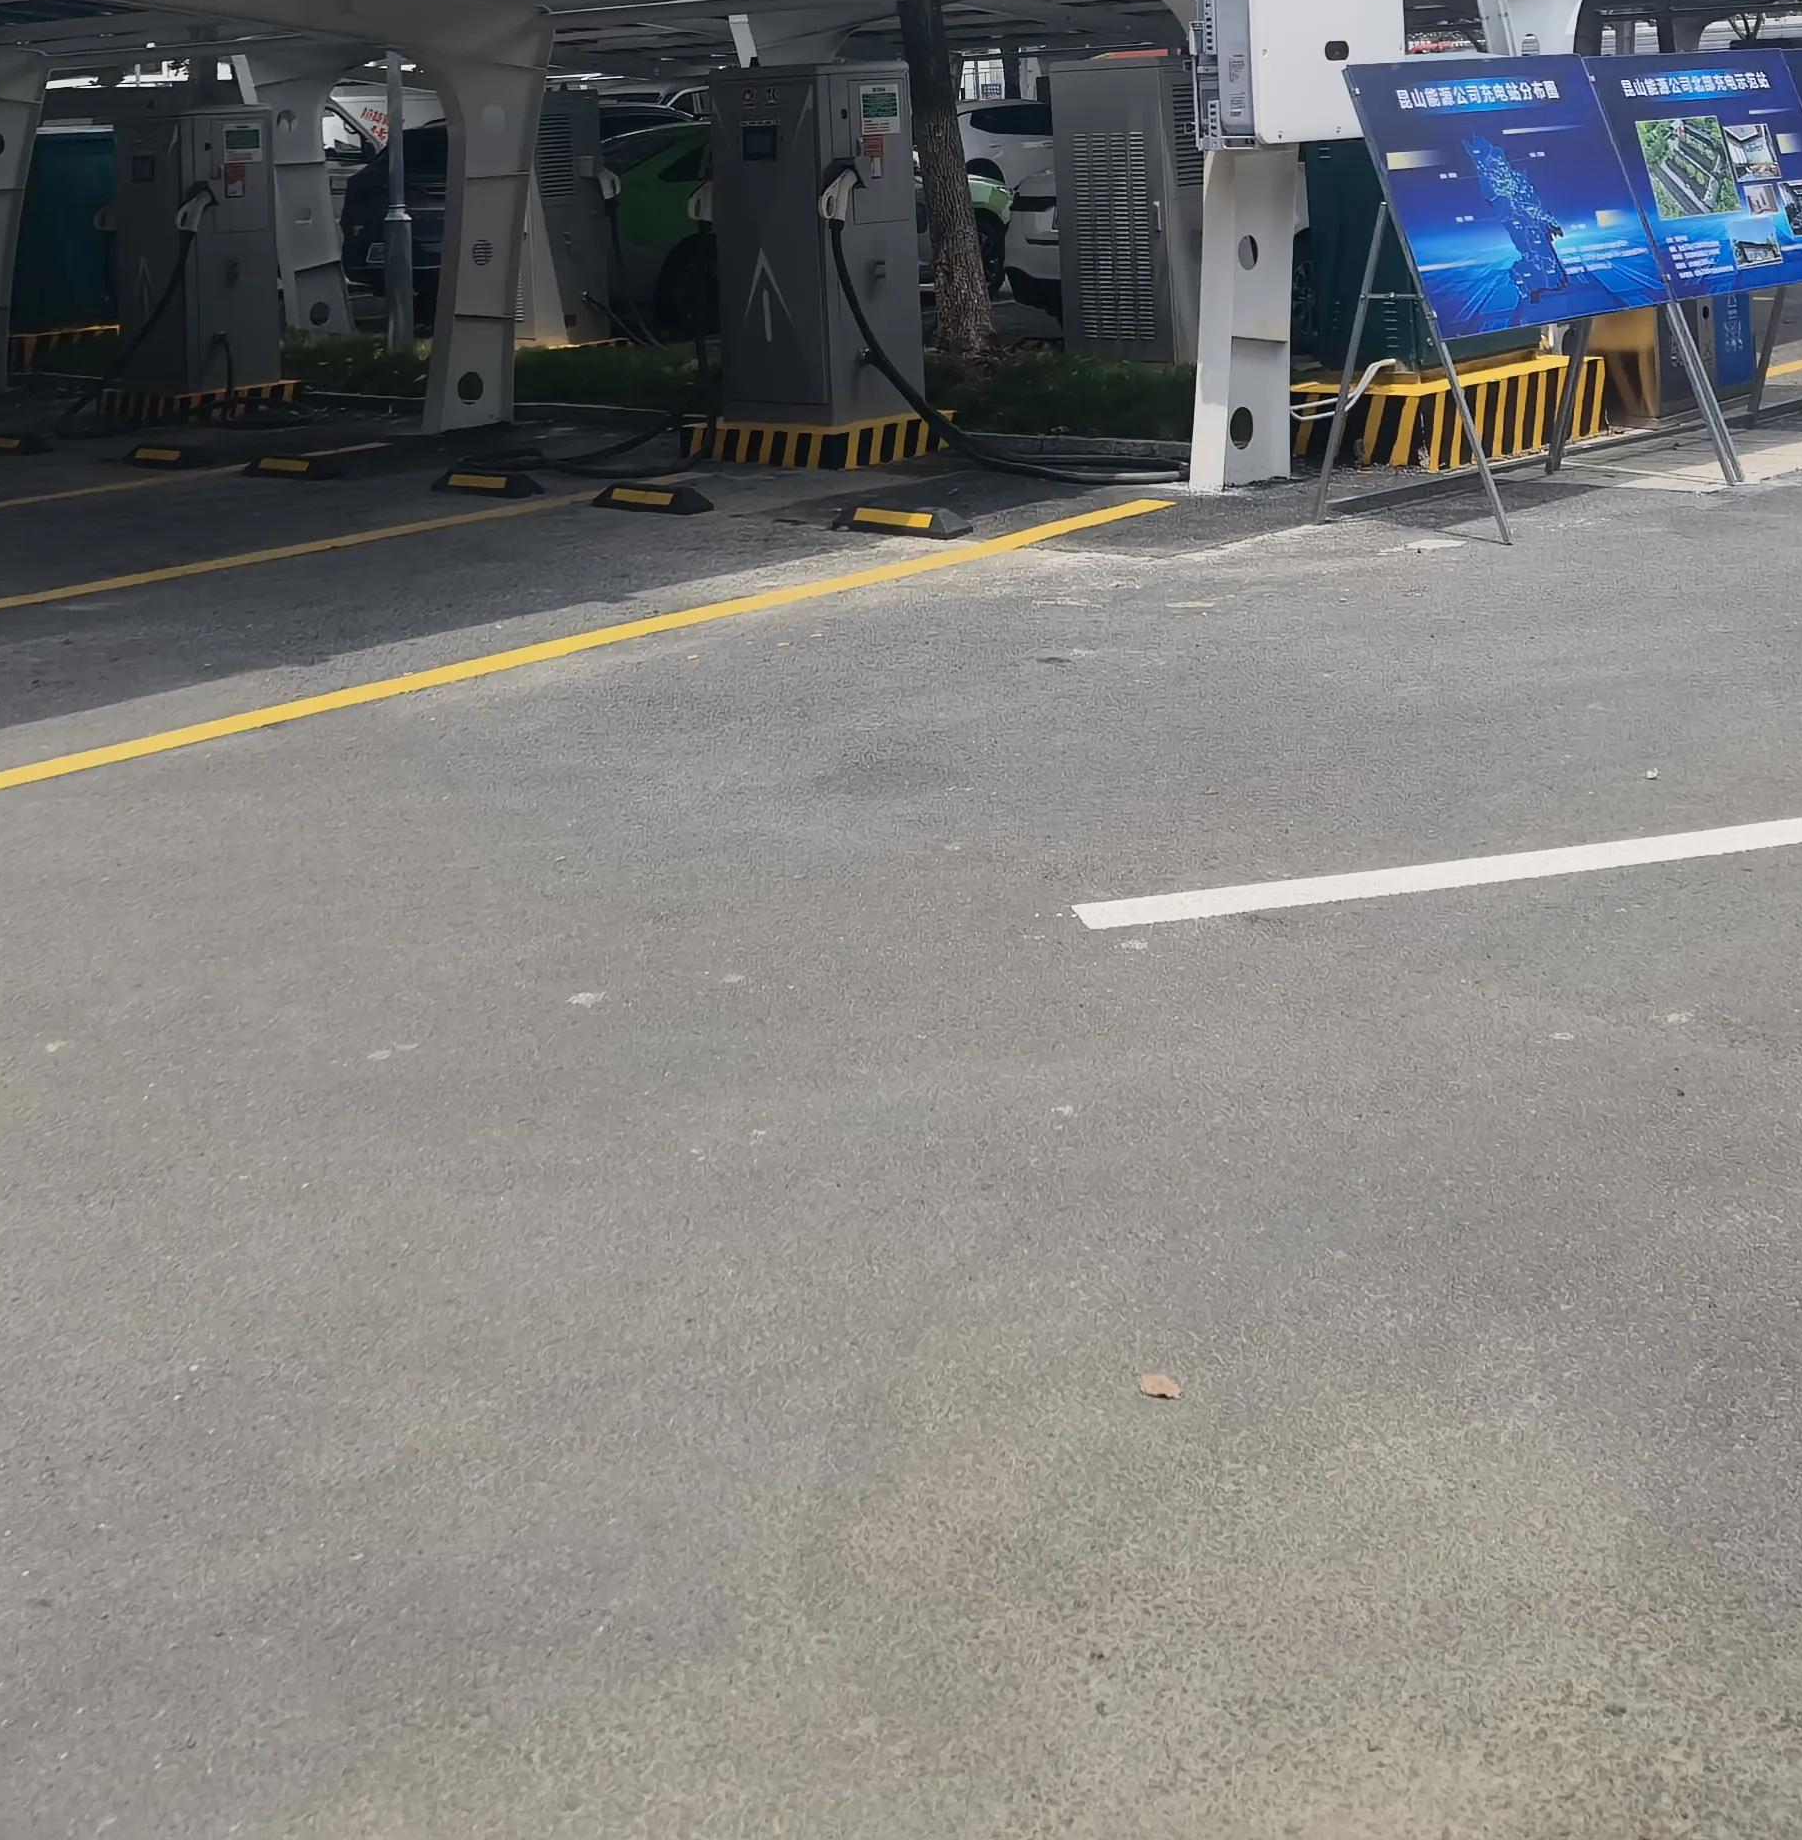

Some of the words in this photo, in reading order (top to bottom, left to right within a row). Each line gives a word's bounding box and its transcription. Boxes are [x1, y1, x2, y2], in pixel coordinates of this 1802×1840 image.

[1396, 80, 1560, 109] 昆山能源公司充电站分布图
[1621, 71, 1771, 98] 昆山能源公司北部充电示范站
